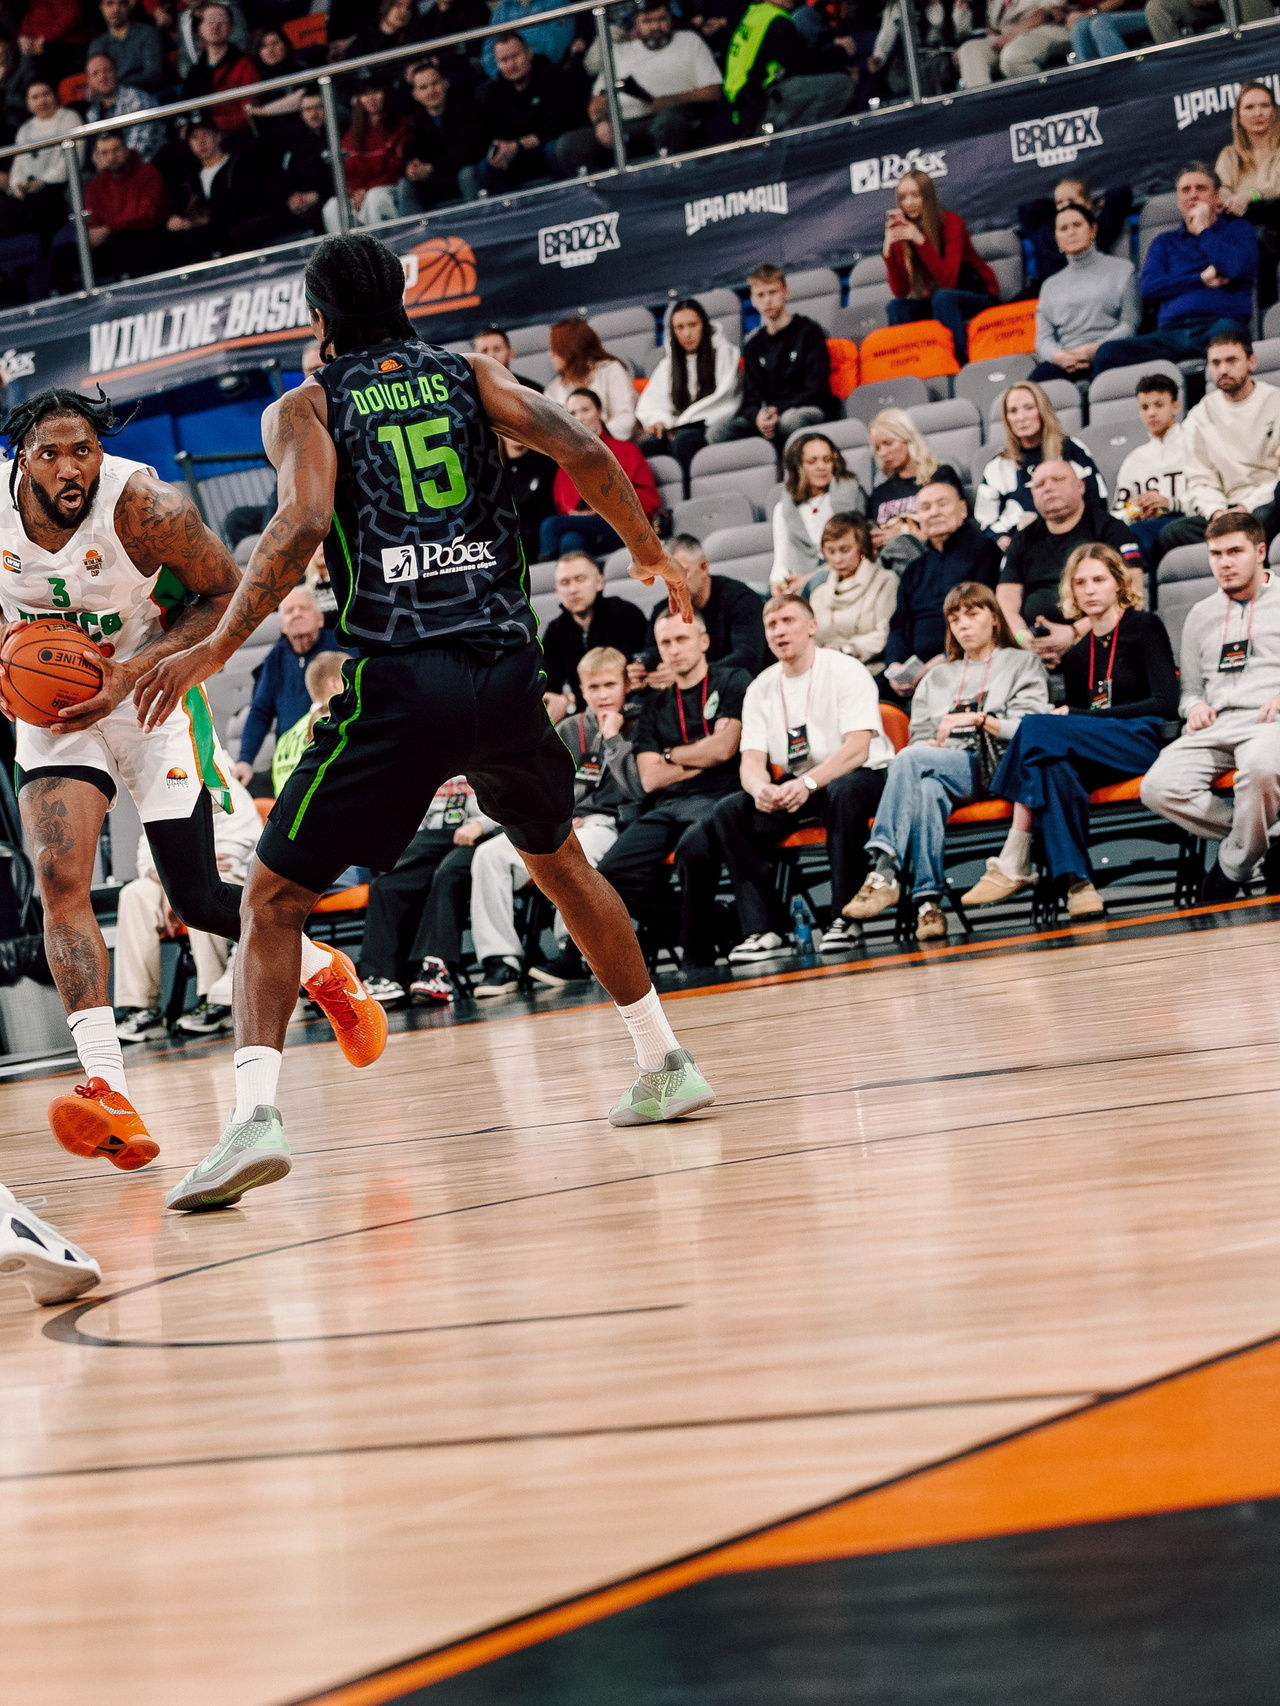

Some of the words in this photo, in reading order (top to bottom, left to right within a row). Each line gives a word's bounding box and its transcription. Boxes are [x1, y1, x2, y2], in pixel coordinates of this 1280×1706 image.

[1174, 74, 1280, 131] УРАЛ
[685, 181, 788, 236] УРАЛМАШ
[90, 296, 225, 375] WINLINE
[224, 278, 312, 340] BASK
[350, 374, 449, 415] DOUGLAS
[378, 417, 468, 513] 15
[419, 534, 496, 570] Робек
[48, 577, 71, 607] 3
